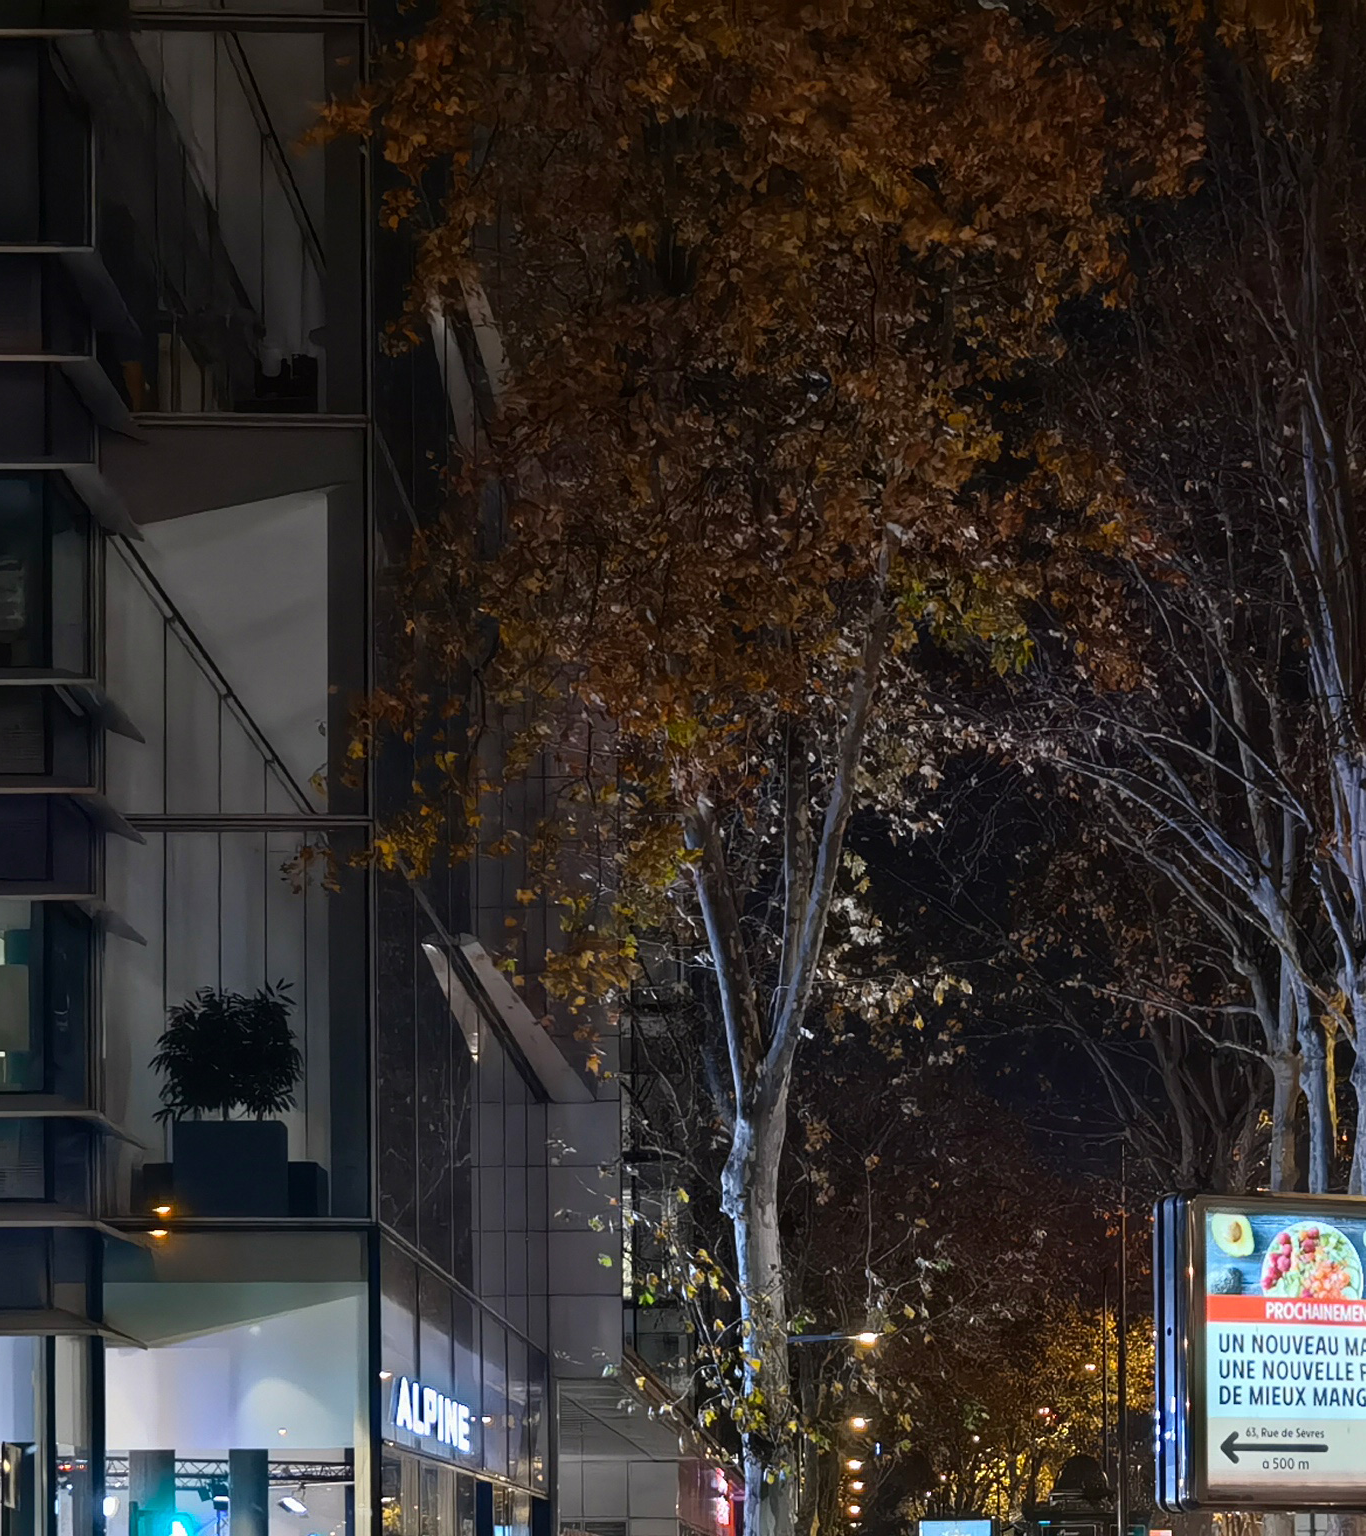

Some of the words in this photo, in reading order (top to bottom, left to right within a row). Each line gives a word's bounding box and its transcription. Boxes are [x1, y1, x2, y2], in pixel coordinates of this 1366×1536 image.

[1219, 1333, 1244, 1353] UN
[1252, 1334, 1339, 1355] NOUVEAU
[1219, 1359, 1256, 1379] UNE
[1262, 1360, 1355, 1382] NOUVELLE
[1219, 1385, 1242, 1405] DE
[1249, 1385, 1306, 1406] MIEUX
[396, 1376, 470, 1453] ALPINE
[1245, 1427, 1259, 1439] 63,
[1261, 1427, 1279, 1438] Rue
[1281, 1427, 1295, 1438] de
[1272, 1457, 1295, 1471] 500
[1297, 1459, 1310, 1471] m
